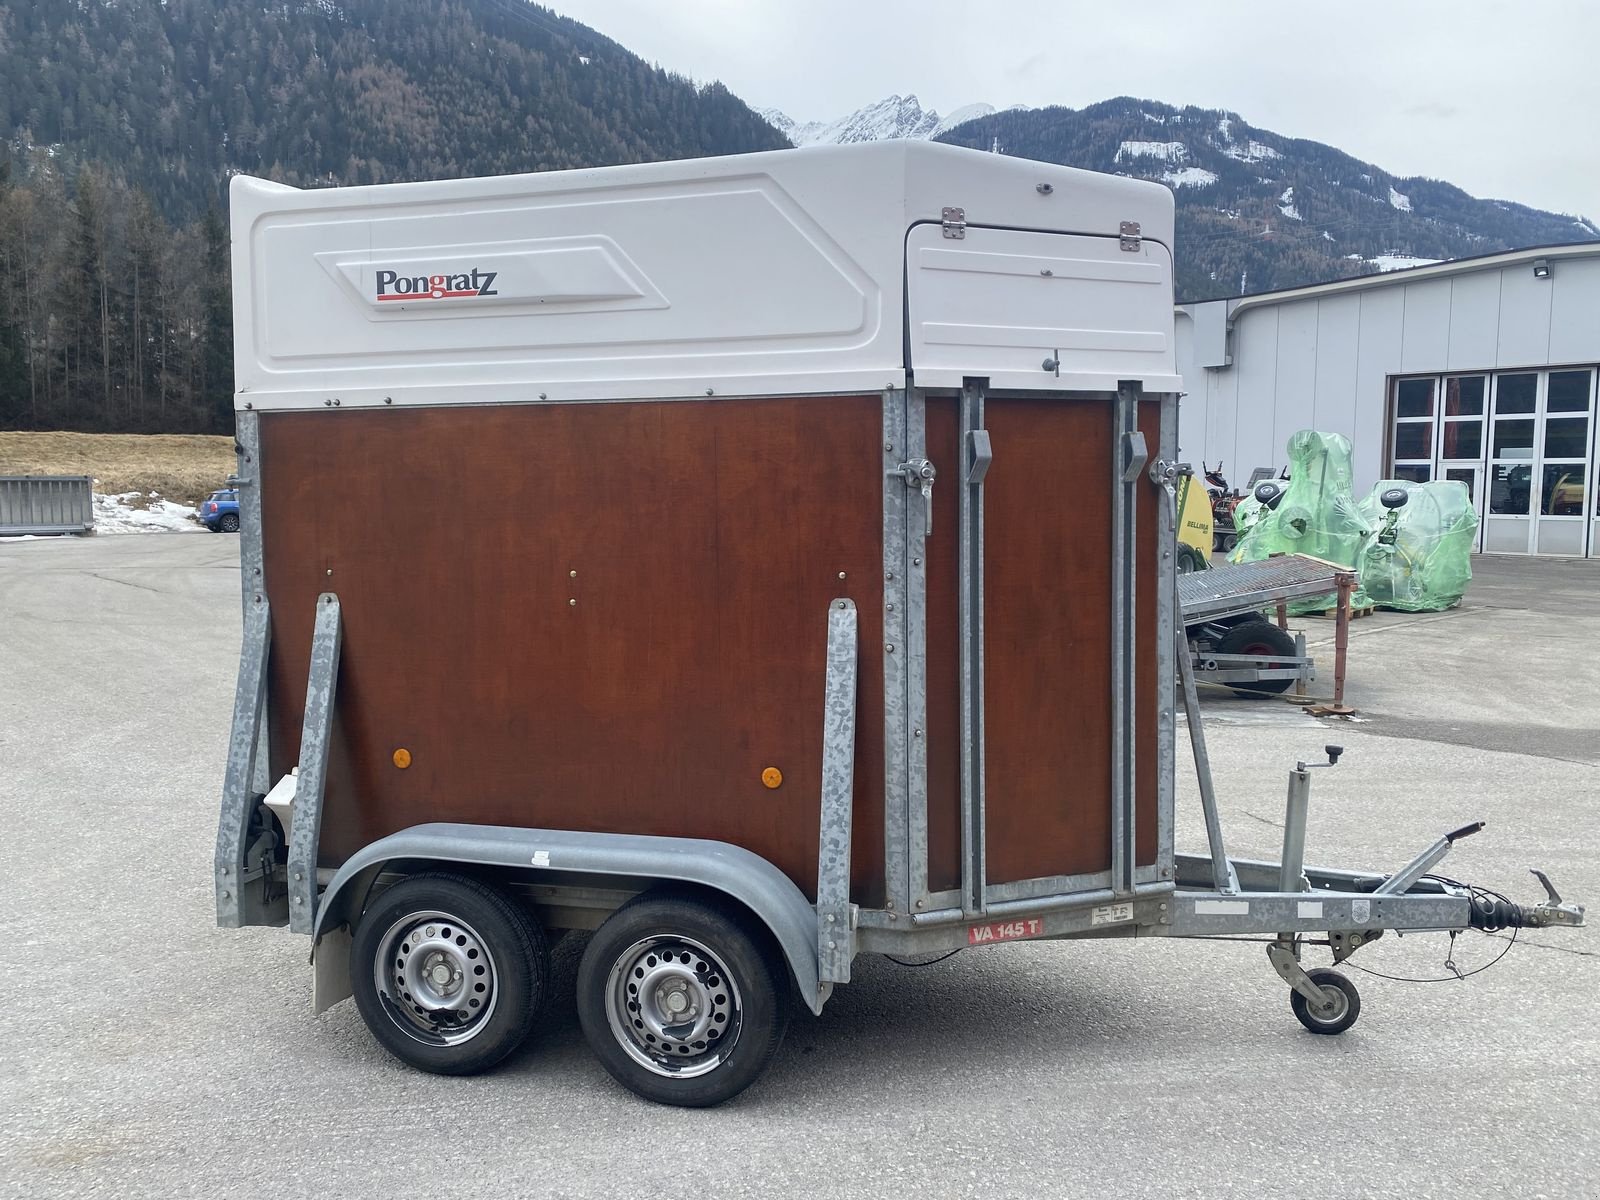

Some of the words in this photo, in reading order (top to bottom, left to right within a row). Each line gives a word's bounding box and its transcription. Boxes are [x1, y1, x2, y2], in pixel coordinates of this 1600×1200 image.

[376, 267, 498, 299] Pongratz
[973, 926, 994, 942] VA
[997, 922, 1024, 938] 145
[1028, 919, 1039, 934] T
